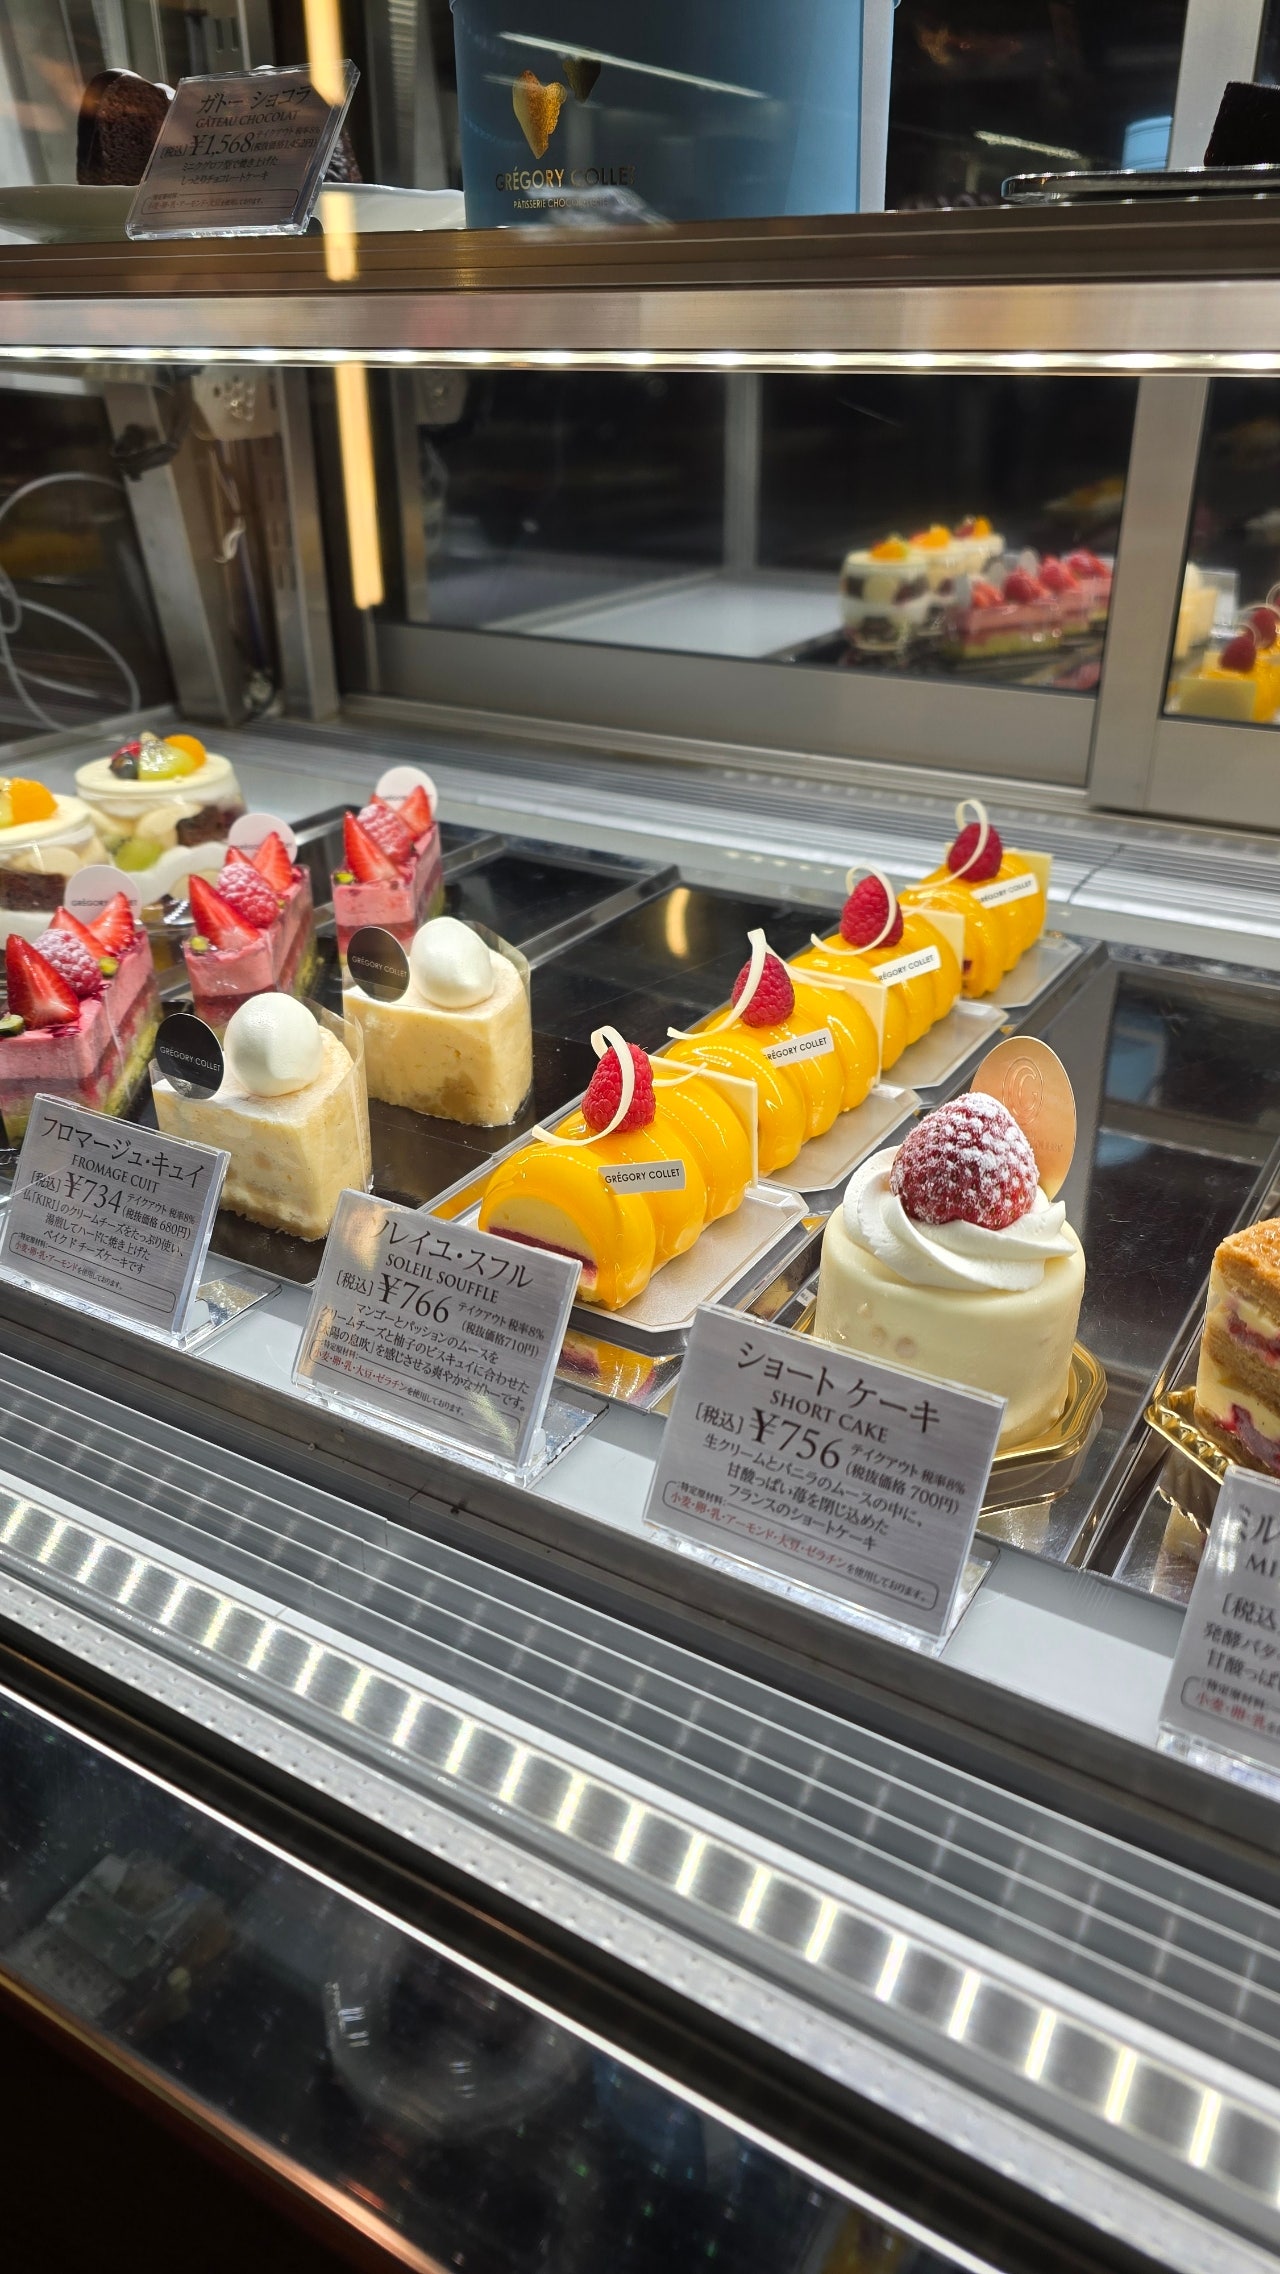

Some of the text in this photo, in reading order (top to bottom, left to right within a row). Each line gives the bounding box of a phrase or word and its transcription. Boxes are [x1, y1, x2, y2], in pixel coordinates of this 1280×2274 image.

[197, 85, 312, 114] ガトー ショコラ
[238, 111, 299, 126] CHOCOLAT
[190, 132, 255, 156] ¥1,568
[495, 166, 565, 192] GRÉGORY
[513, 198, 547, 209] PÂTISSERIE
[383, 965, 408, 978] COLLET
[876, 954, 934, 981] RÉGORY COLLET
[160, 1045, 221, 1072] GRÉGORY COLLET
[799, 1037, 827, 1052] COLLET
[41, 1117, 204, 1188] フロマージュ・キュイ
[64, 1171, 123, 1214] ¥734
[126, 1193, 167, 1215] テイクアウト
[71, 1154, 160, 1194] FROMAGE CUIT
[604, 1168, 680, 1184] GRÉGORY COLLET
[45, 1212, 151, 1261] 湯煎してハードに焼き上げた
[377, 1272, 452, 1324] ¥766
[458, 1301, 507, 1327] テイクアウト
[385, 1253, 499, 1304] SOLEIL SOUFFLE
[356, 1303, 499, 1365] マンゴーとパッションのムースを
[737, 1342, 940, 1434] ショート ケーキ
[769, 1390, 888, 1444] SHORT CAKE
[750, 1407, 841, 1469] ¥756
[851, 1443, 918, 1478] テイクアウト
[727, 1461, 888, 1535] 甘酸っぱい苺を閉じ込めた
[729, 1483, 876, 1551] フランスのショートケーキ
[1203, 1621, 1280, 1661] 発酵バタ
[1207, 1648, 1280, 1692] 甘酸っぱ
